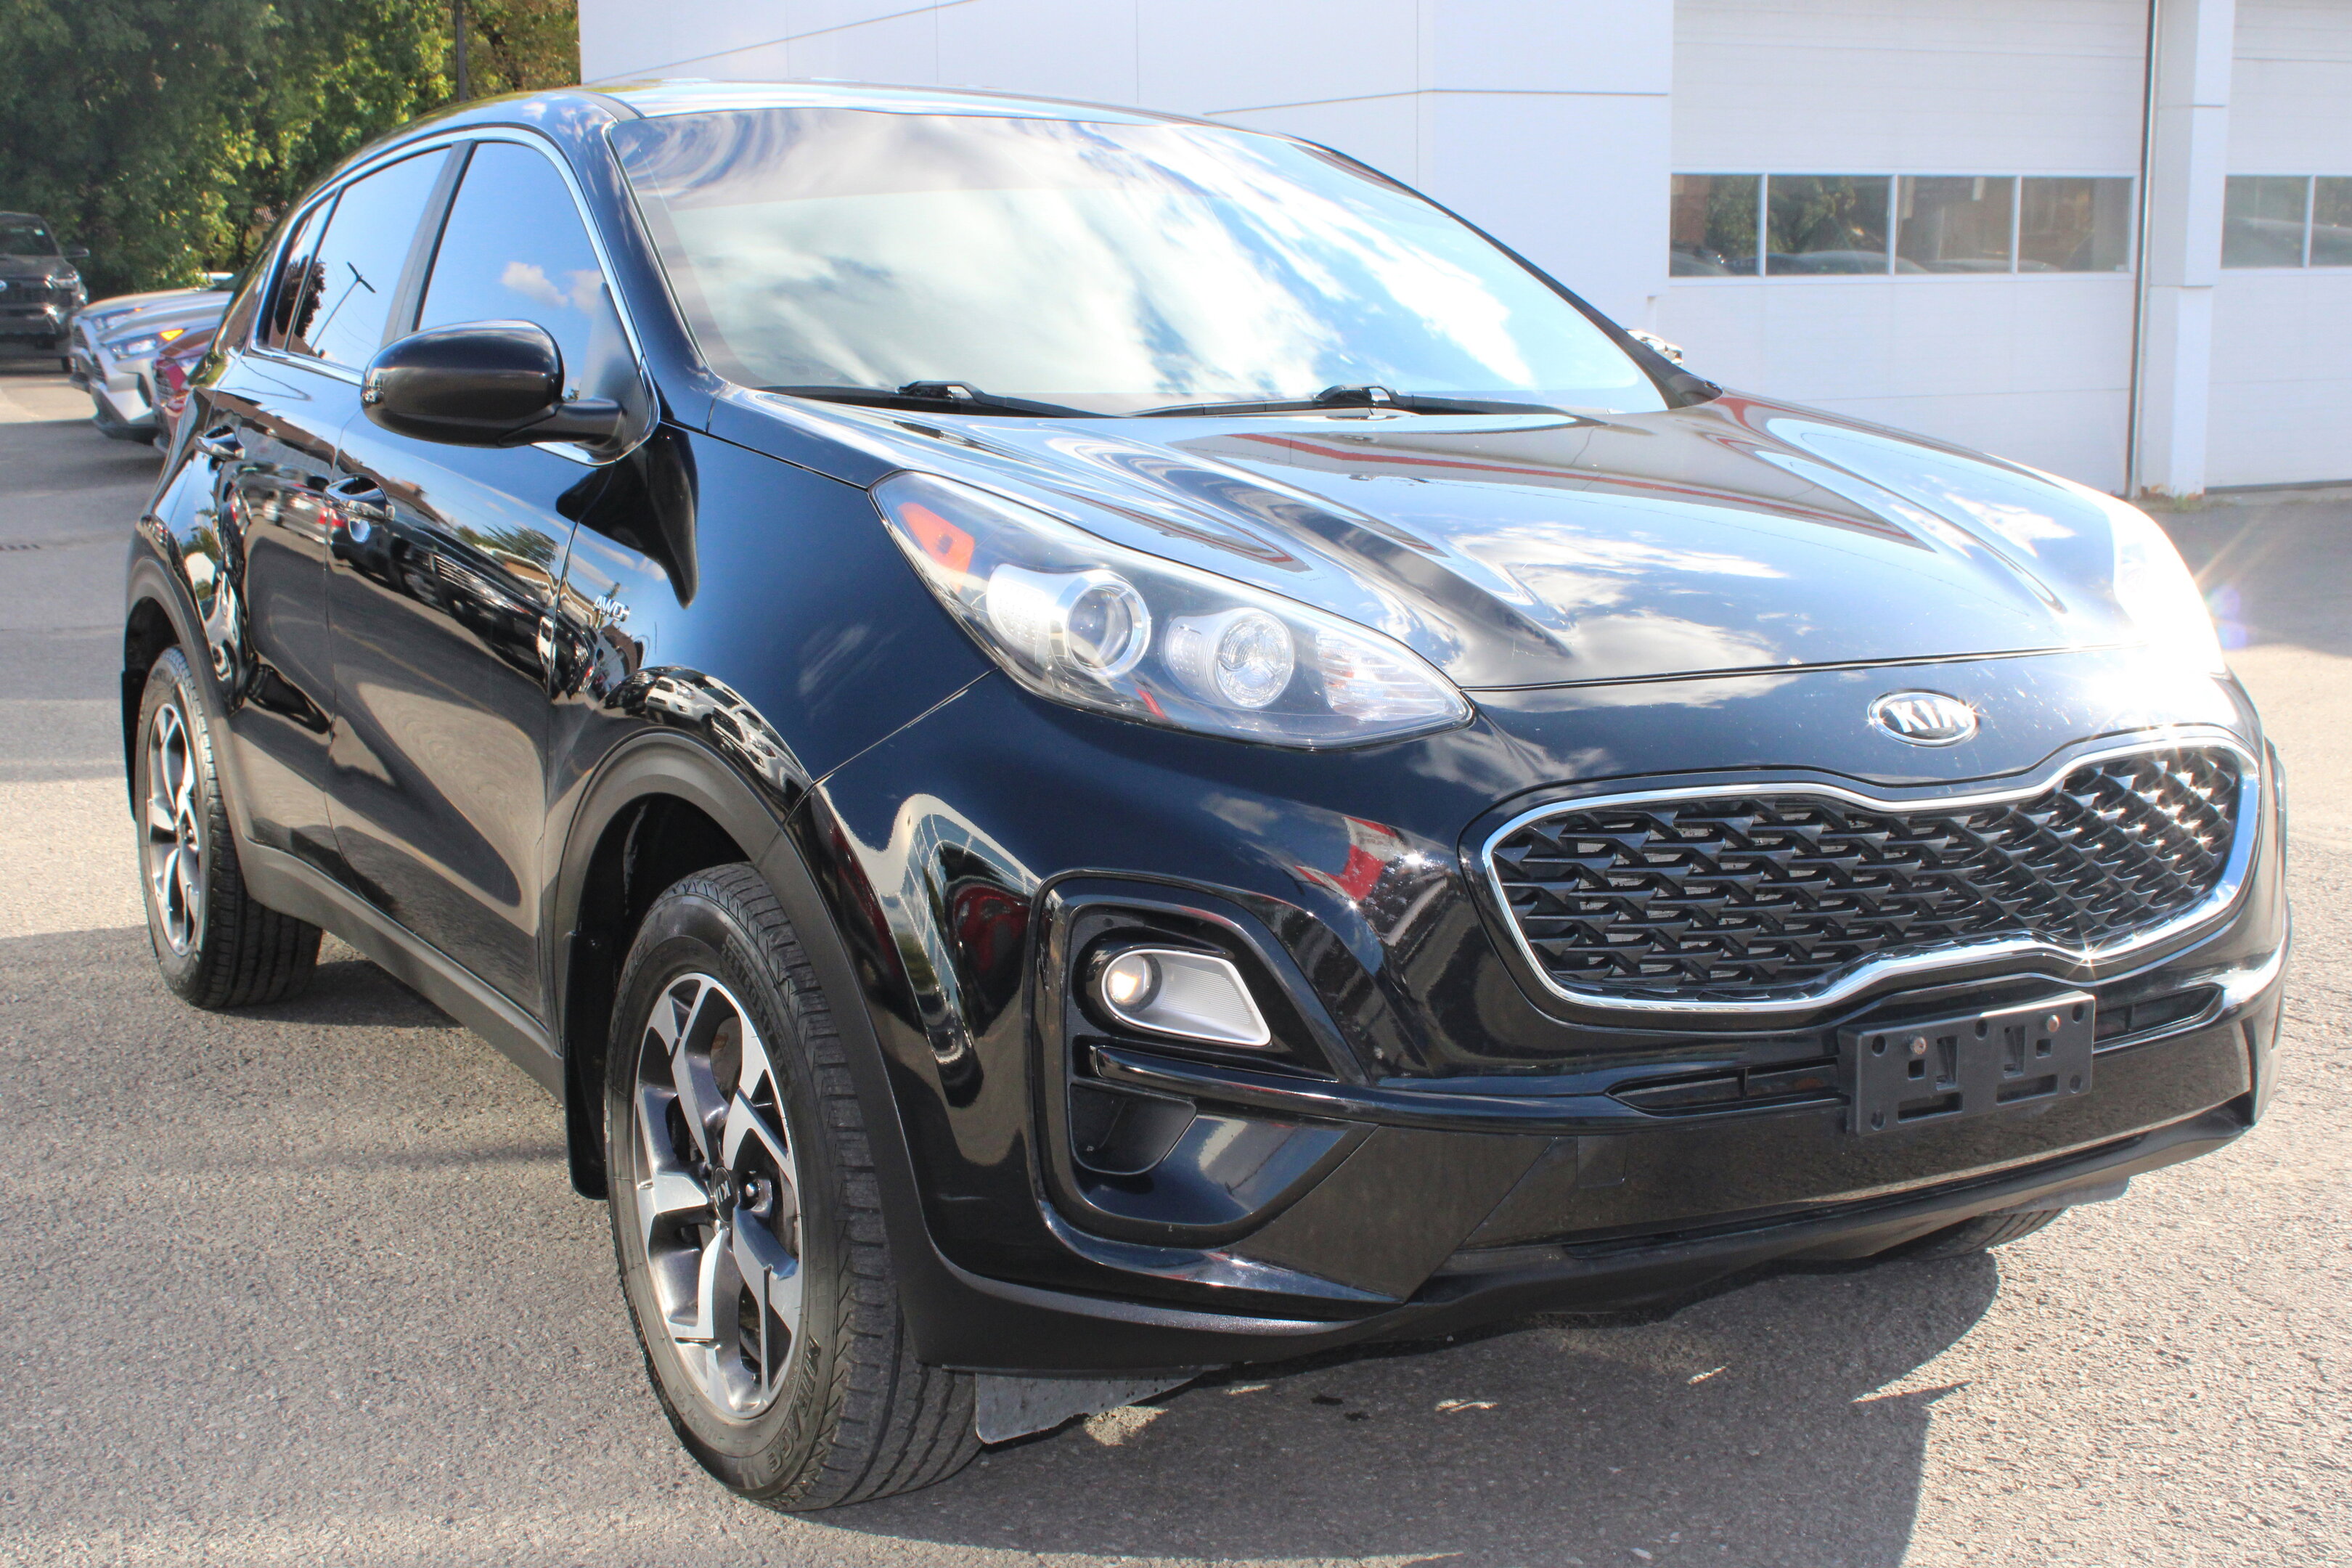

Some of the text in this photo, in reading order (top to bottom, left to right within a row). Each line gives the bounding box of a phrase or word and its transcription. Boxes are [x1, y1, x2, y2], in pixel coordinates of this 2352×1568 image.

[594, 595, 627, 621] AWD
[1885, 700, 1973, 733] KIA
[767, 1333, 821, 1474] MIRAGE
